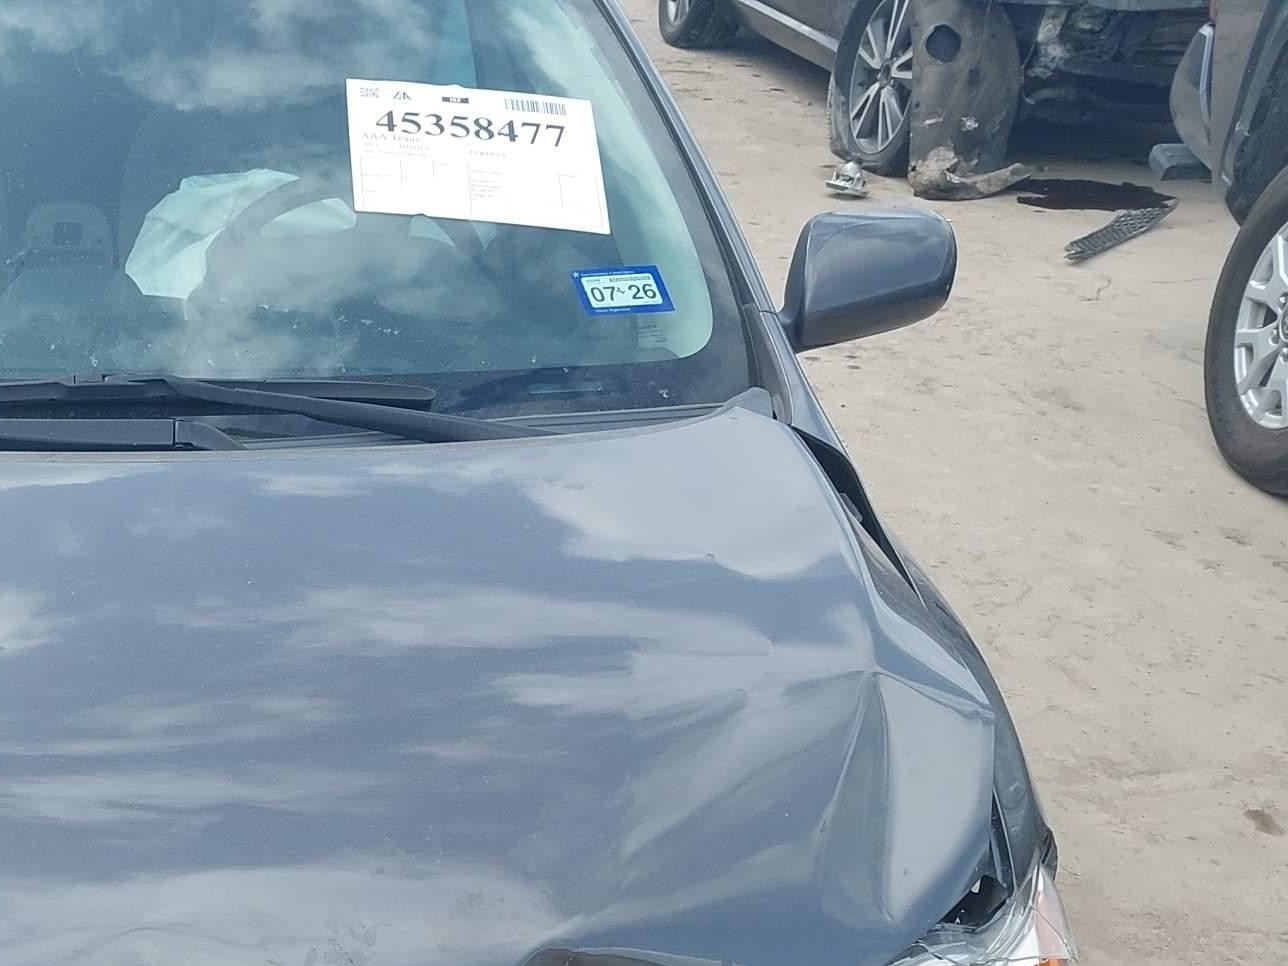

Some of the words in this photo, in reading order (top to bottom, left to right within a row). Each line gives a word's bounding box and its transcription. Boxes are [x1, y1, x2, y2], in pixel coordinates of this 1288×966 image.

[375, 109, 567, 148] 45358477
[590, 286, 616, 303] 07
[628, 283, 657, 300] 26
